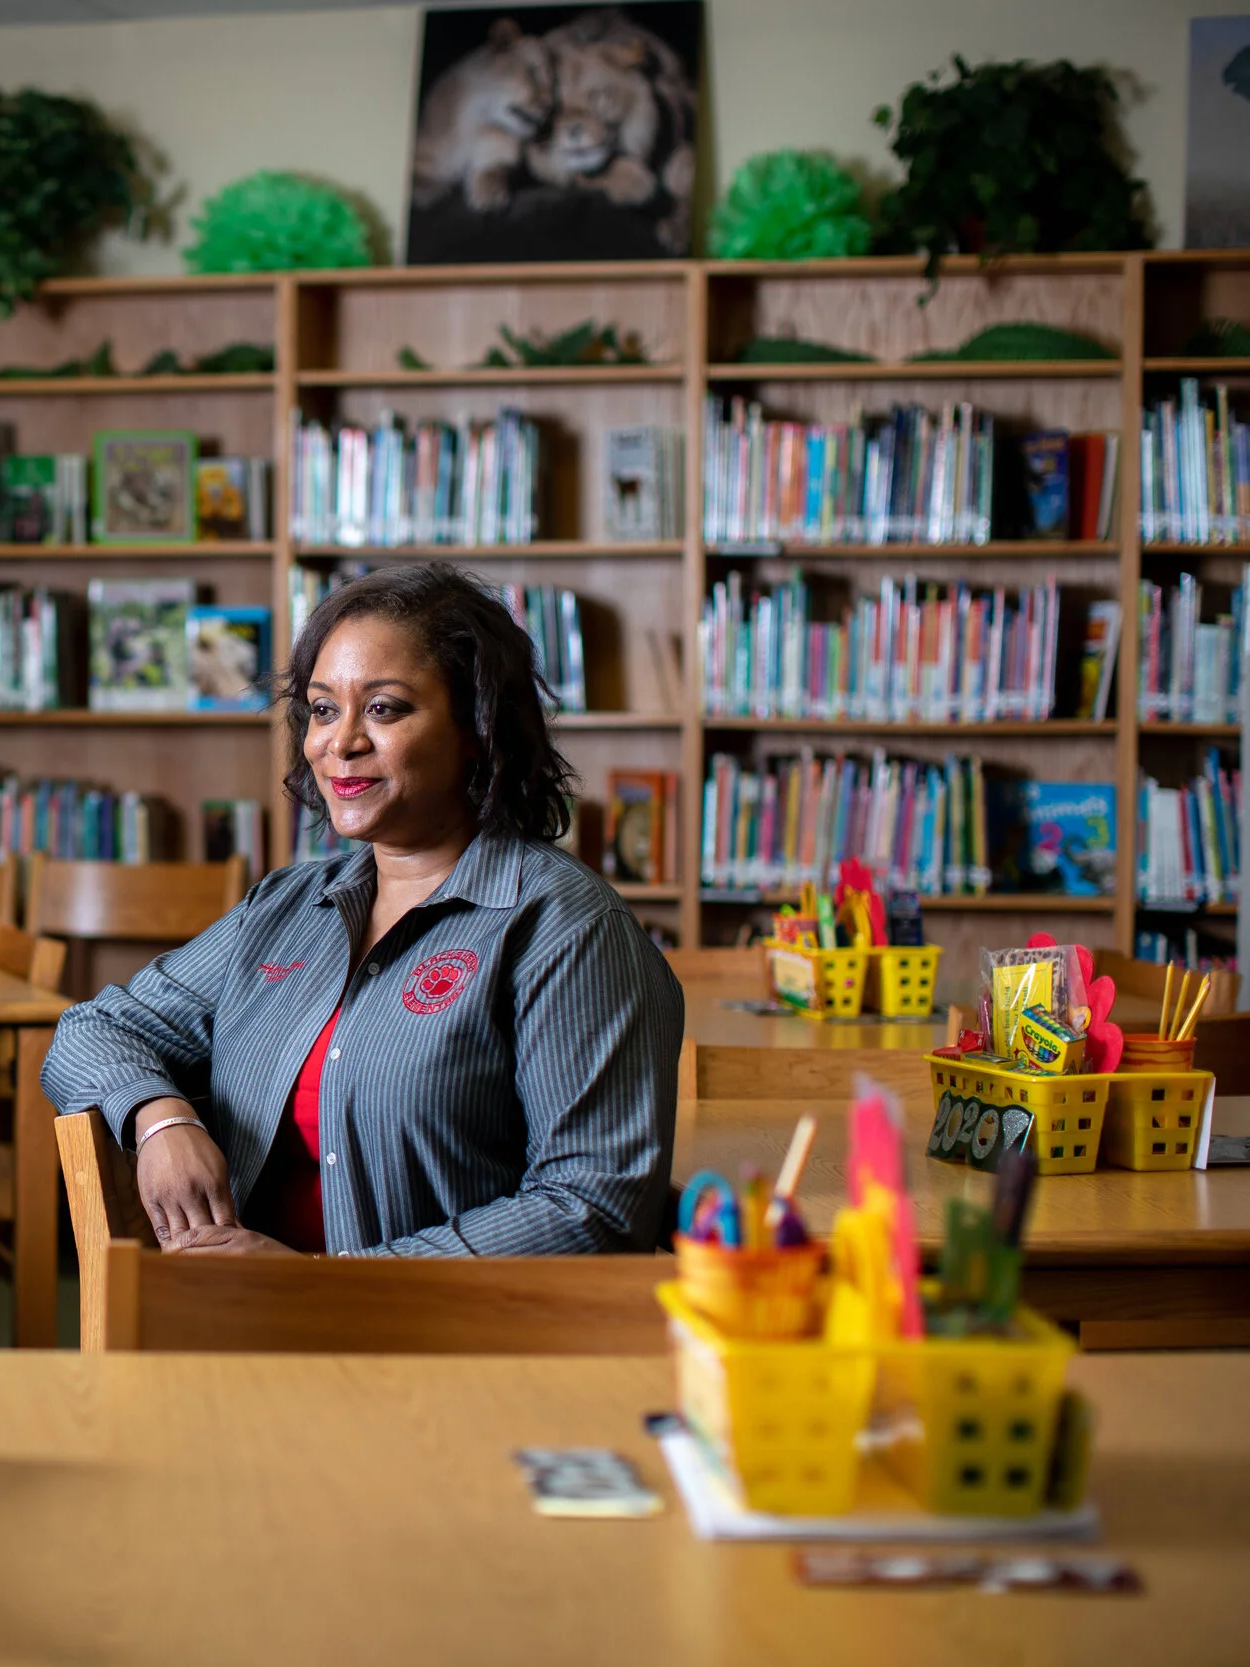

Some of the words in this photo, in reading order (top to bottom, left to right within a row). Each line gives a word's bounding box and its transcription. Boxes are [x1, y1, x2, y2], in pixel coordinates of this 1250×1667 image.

[403, 984, 464, 1014] ELEMENTARY
[1025, 1025, 1058, 1052] Crayola
[929, 1096, 1000, 1160] 2020
